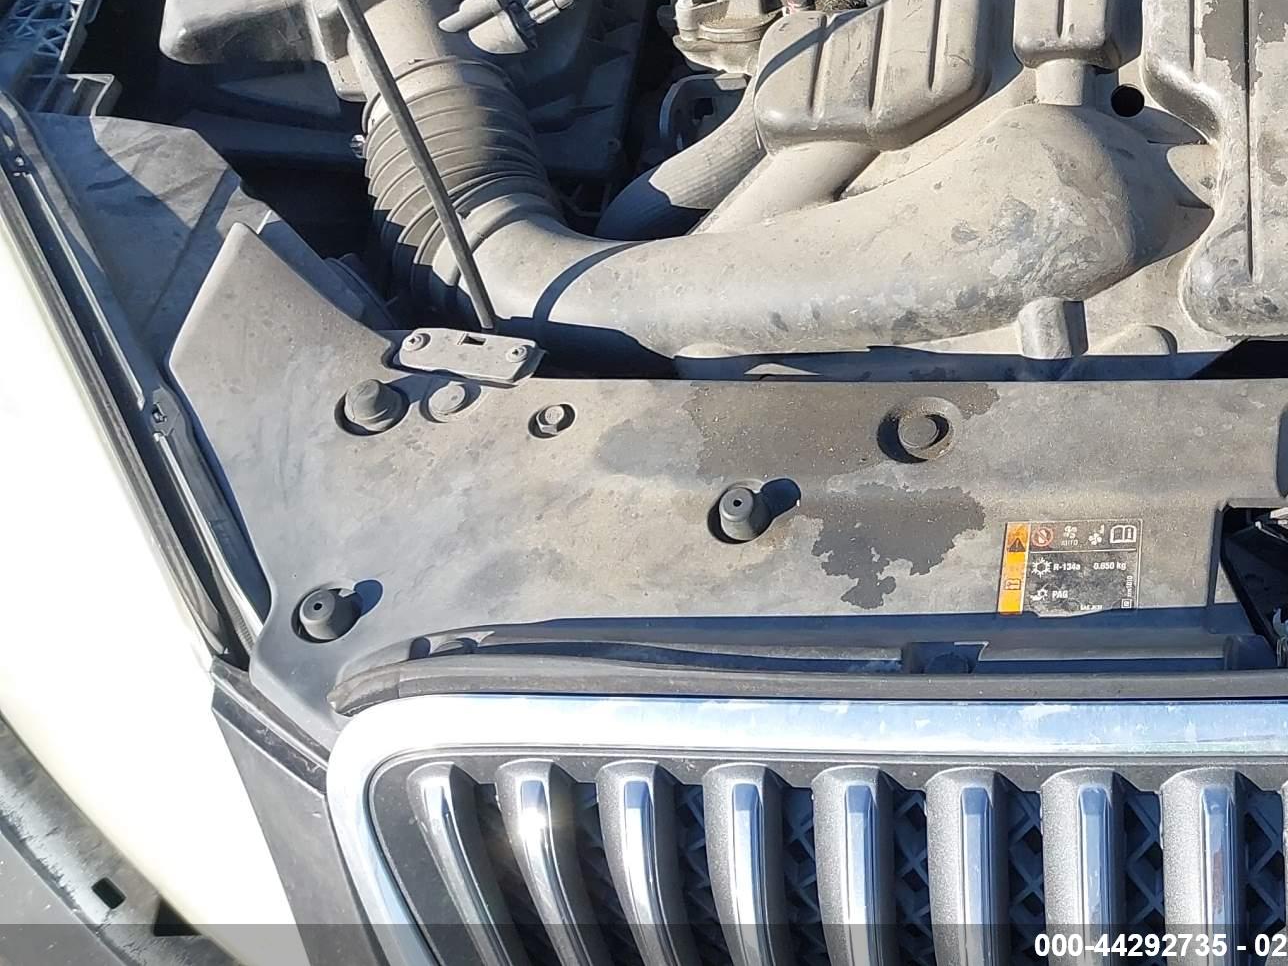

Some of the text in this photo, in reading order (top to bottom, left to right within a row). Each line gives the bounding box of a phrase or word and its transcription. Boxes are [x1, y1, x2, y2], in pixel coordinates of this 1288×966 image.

[1053, 562, 1081, 571] R-134a
[1116, 561, 1127, 571] kg
[1052, 590, 1069, 599] PAG
